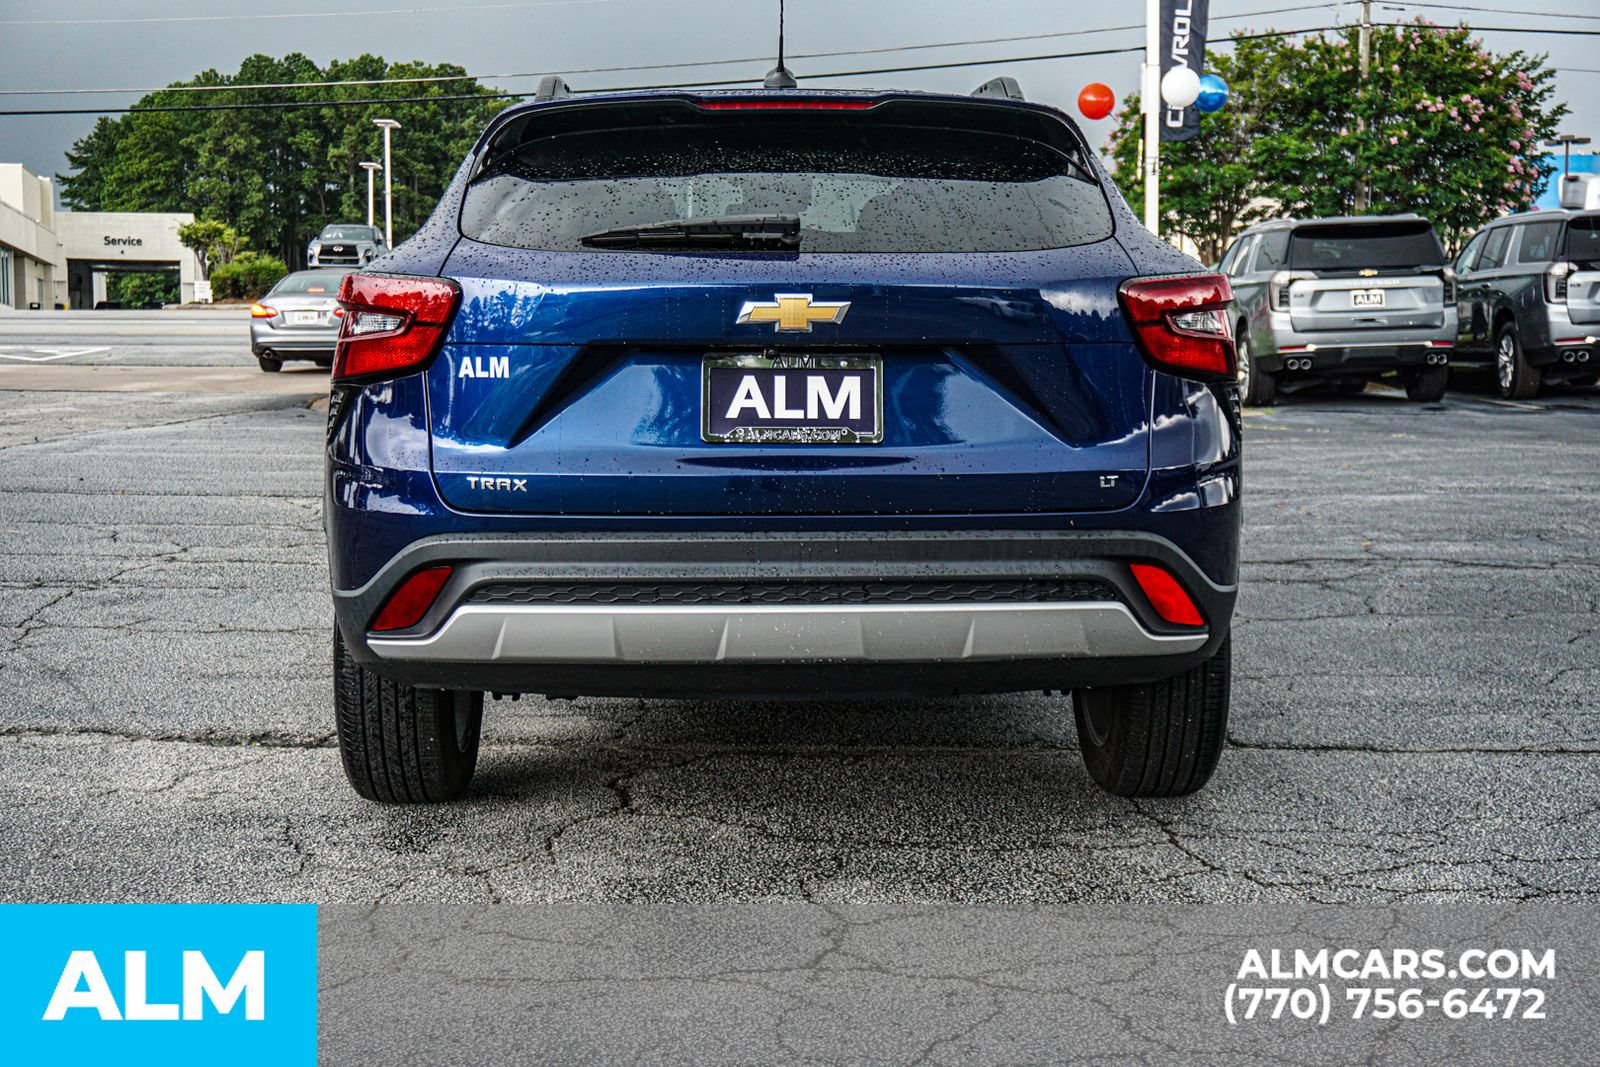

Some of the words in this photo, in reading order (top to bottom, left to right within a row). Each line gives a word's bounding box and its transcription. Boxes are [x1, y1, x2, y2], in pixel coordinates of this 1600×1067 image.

[1166, 0, 1193, 128] CVROL
[103, 235, 143, 246] Service
[1355, 294, 1382, 304] ALM
[458, 356, 510, 379] ALM
[725, 375, 861, 420] ALM
[466, 476, 528, 492] TRAX
[1099, 475, 1119, 488] LT
